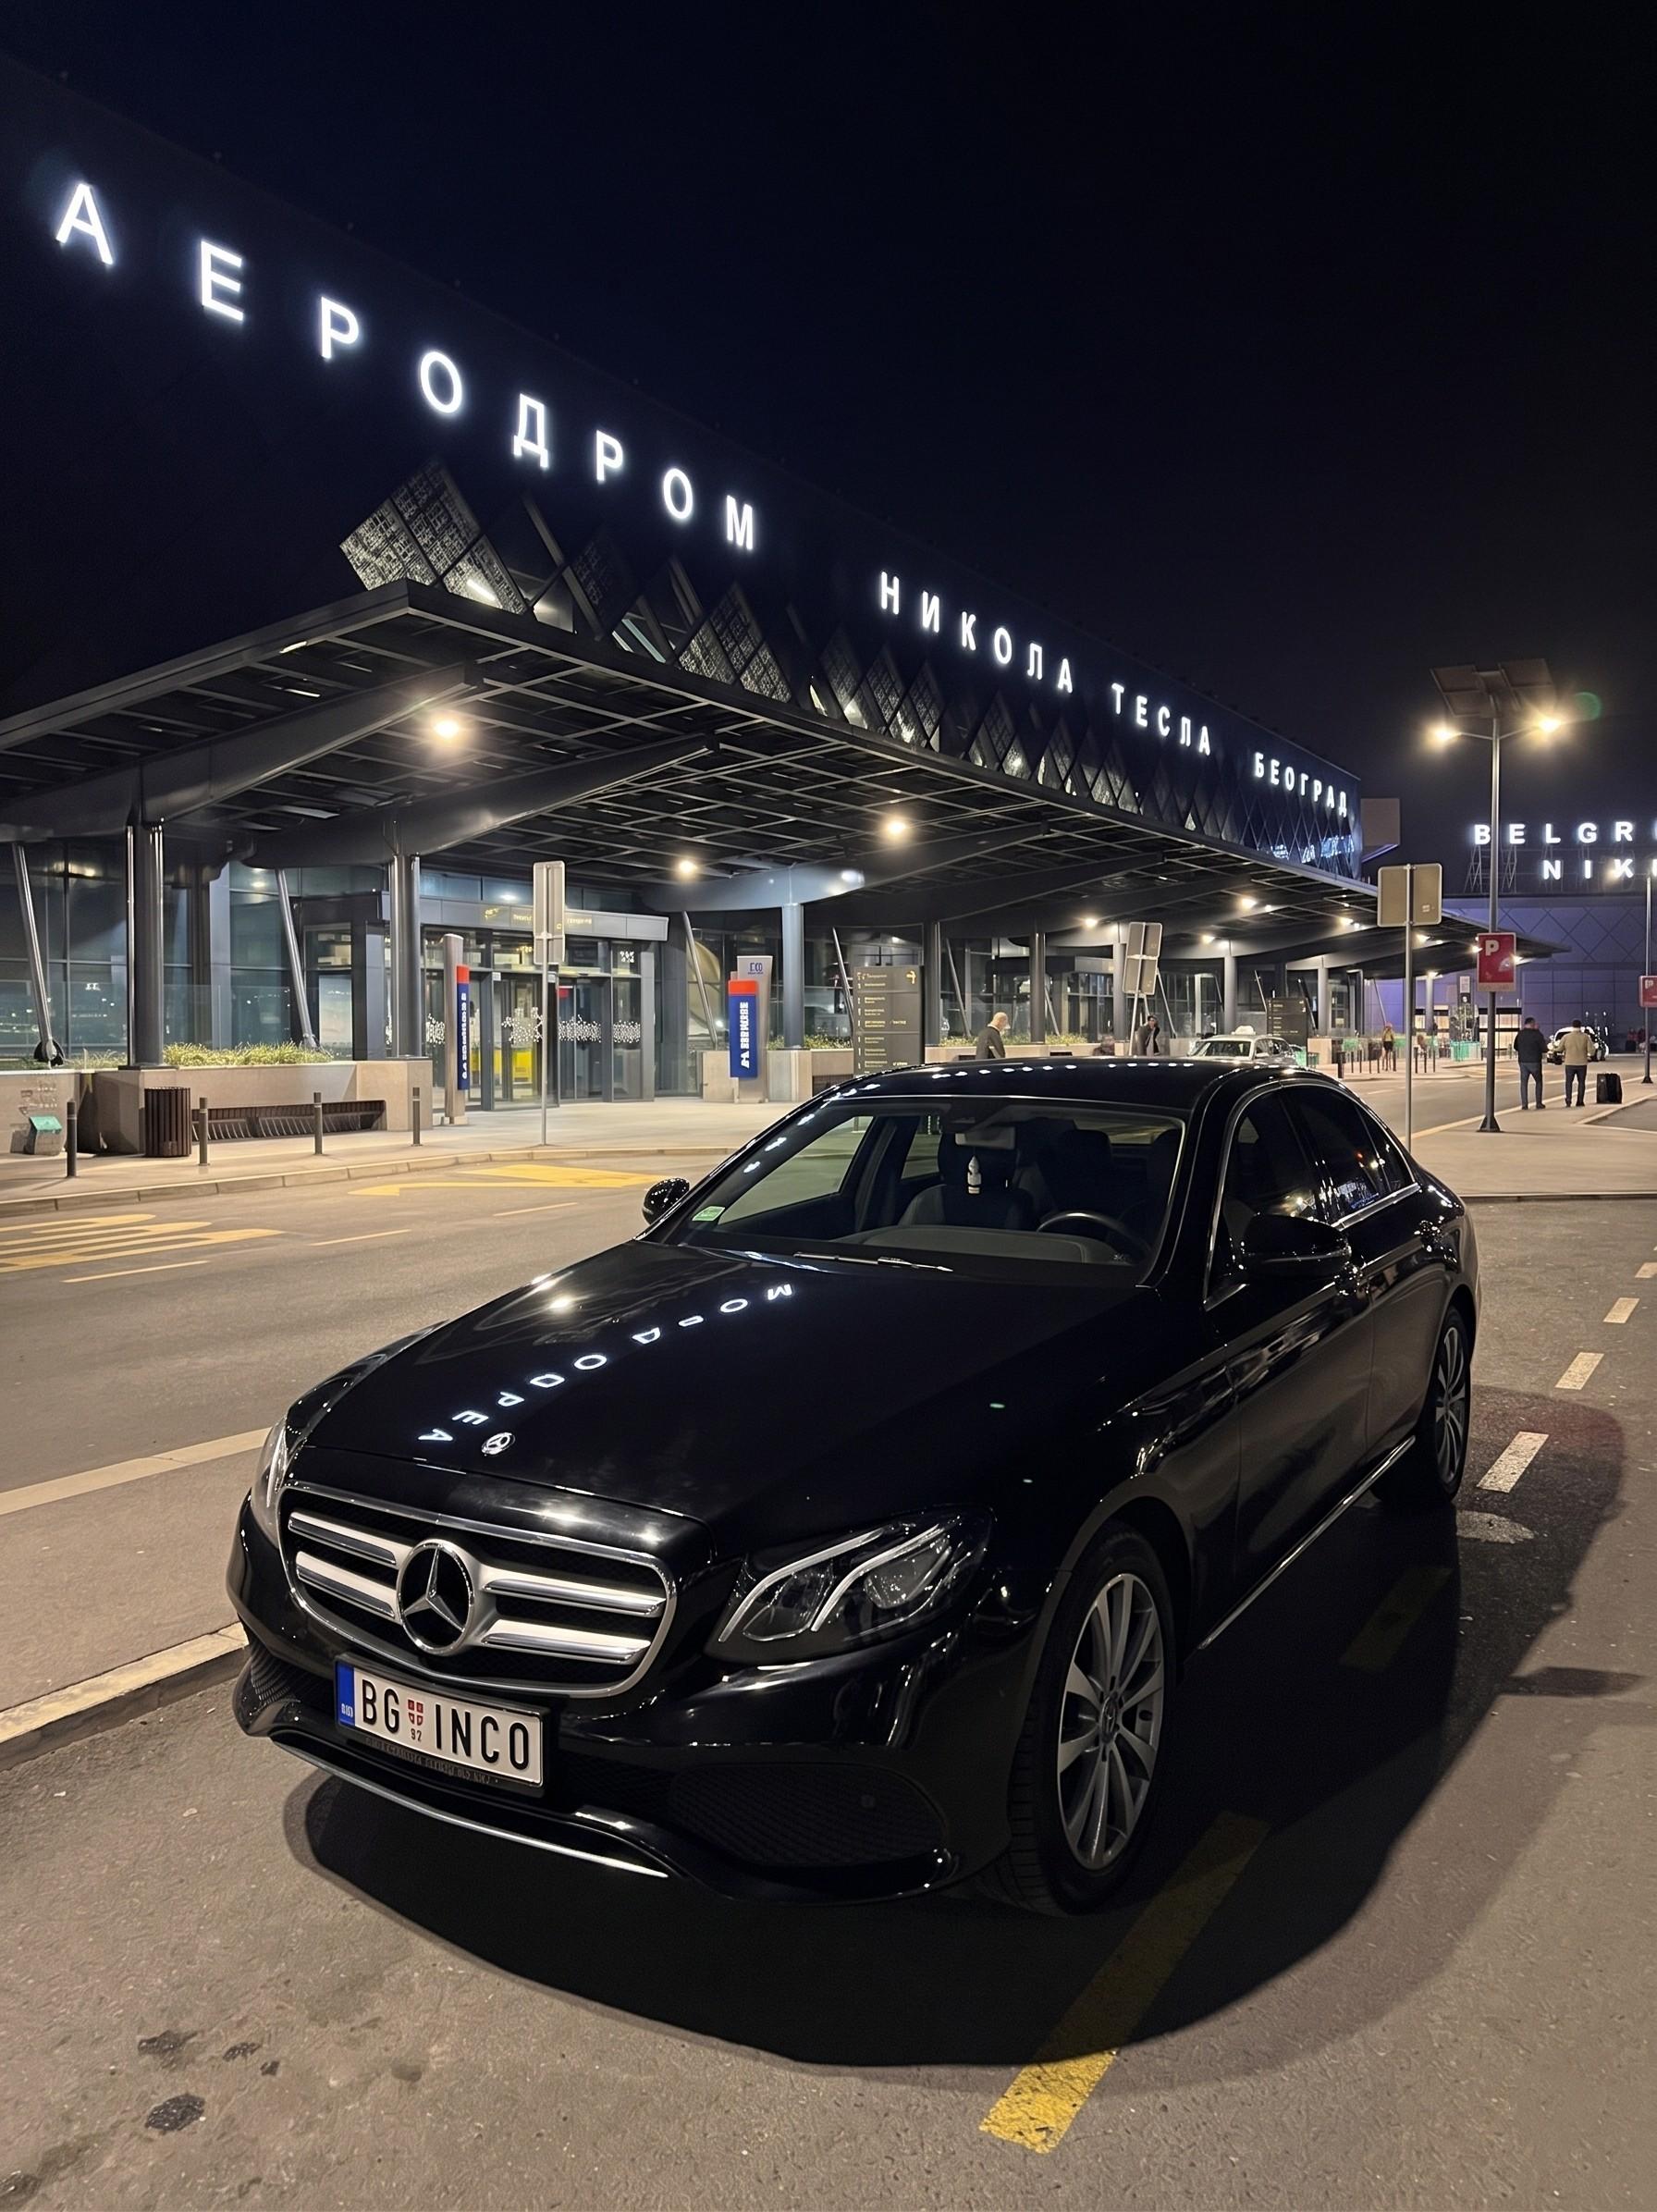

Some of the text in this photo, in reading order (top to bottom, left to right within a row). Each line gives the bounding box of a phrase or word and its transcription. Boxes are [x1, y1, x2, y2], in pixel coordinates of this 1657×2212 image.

[55, 180, 1348, 818] АЕРОДРОМ НИКОЛА ТЕСЛА БЕОГРАД
[1473, 820, 1657, 845] BELGR
[1542, 858, 1657, 880] NIK
[1485, 940, 1500, 956] P
[362, 1678, 530, 1771] BG INCO
